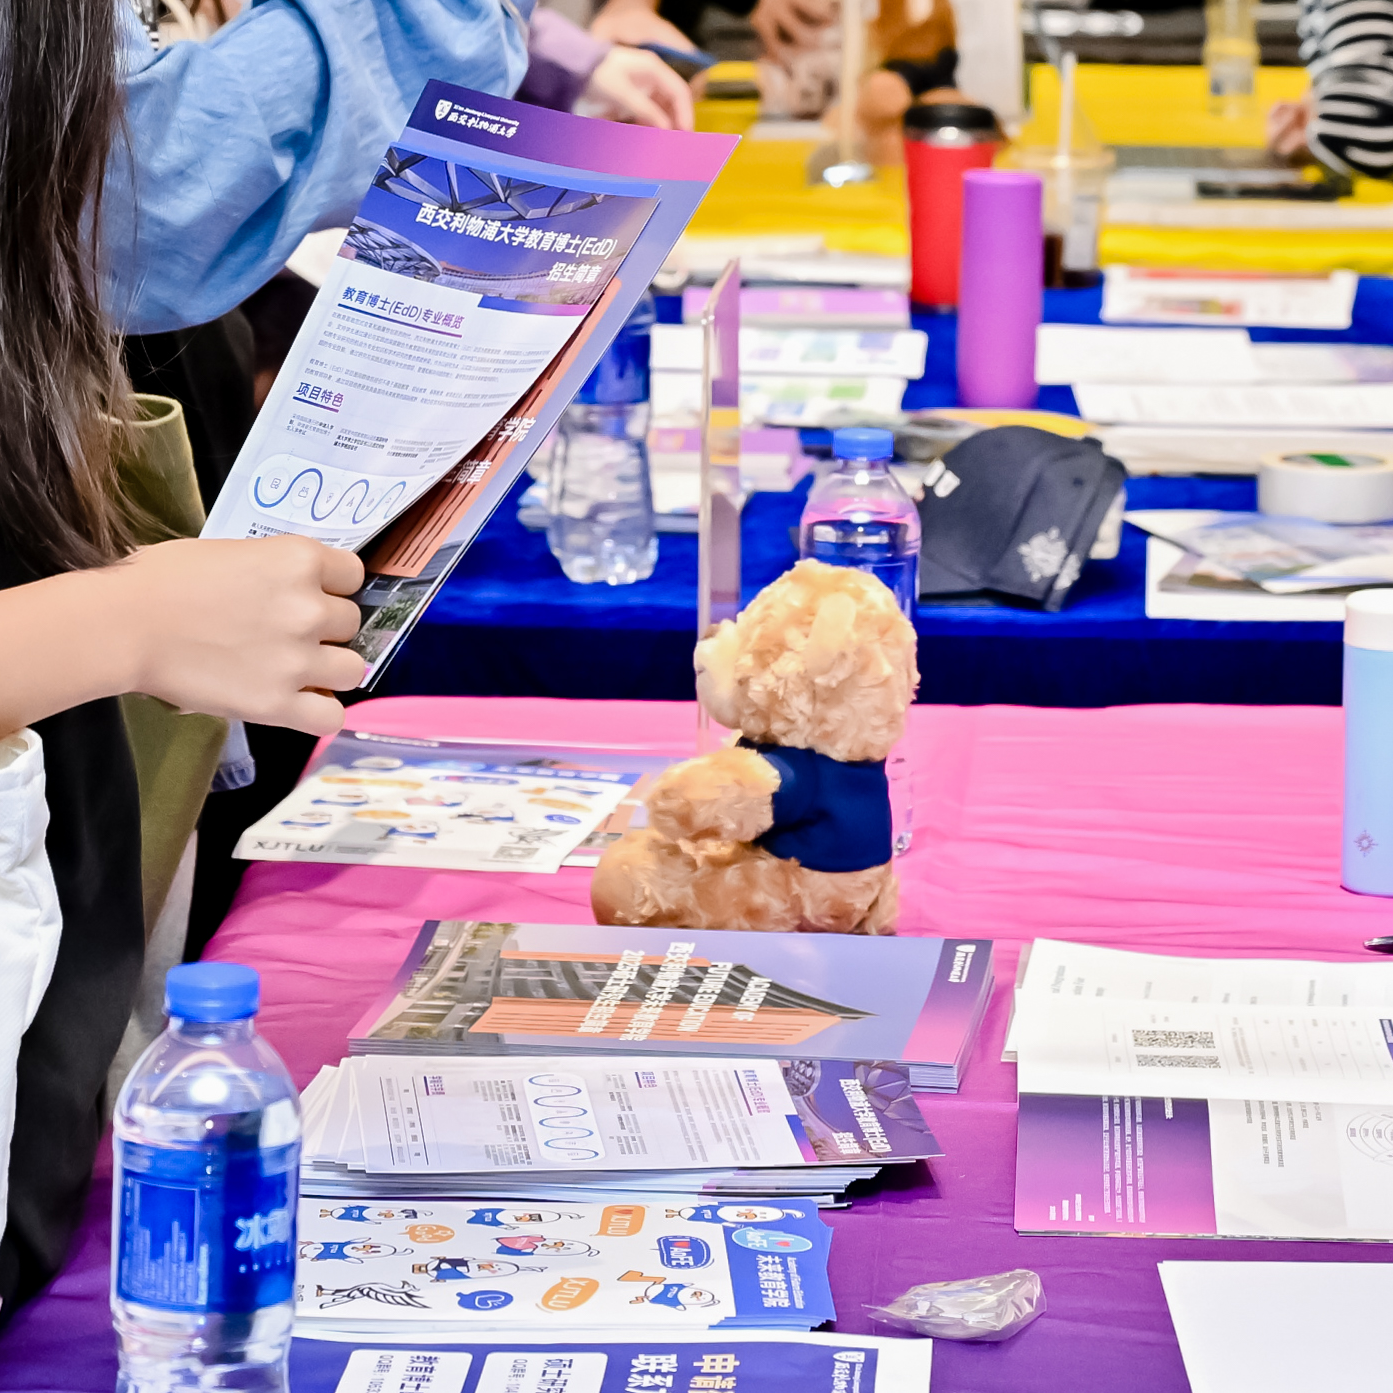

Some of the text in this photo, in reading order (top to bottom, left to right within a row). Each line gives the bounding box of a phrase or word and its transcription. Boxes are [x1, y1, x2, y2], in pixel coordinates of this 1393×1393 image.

[415, 202, 618, 259] 西交利物浦大学教育博士(EdD)
[546, 262, 603, 284] 招生简章
[342, 285, 465, 330] 教育博士(EdD)专业概览
[295, 381, 344, 408] 项目特色
[675, 961, 733, 1032] FUTURE EDUCATION
[731, 975, 772, 1022] ACADEMY OF
[547, 1278, 584, 1310] XJTLU
[755, 1254, 791, 1308] 未来教育学院
[399, 1355, 441, 1393] 教育博士
[687, 1353, 740, 1393] 申请
